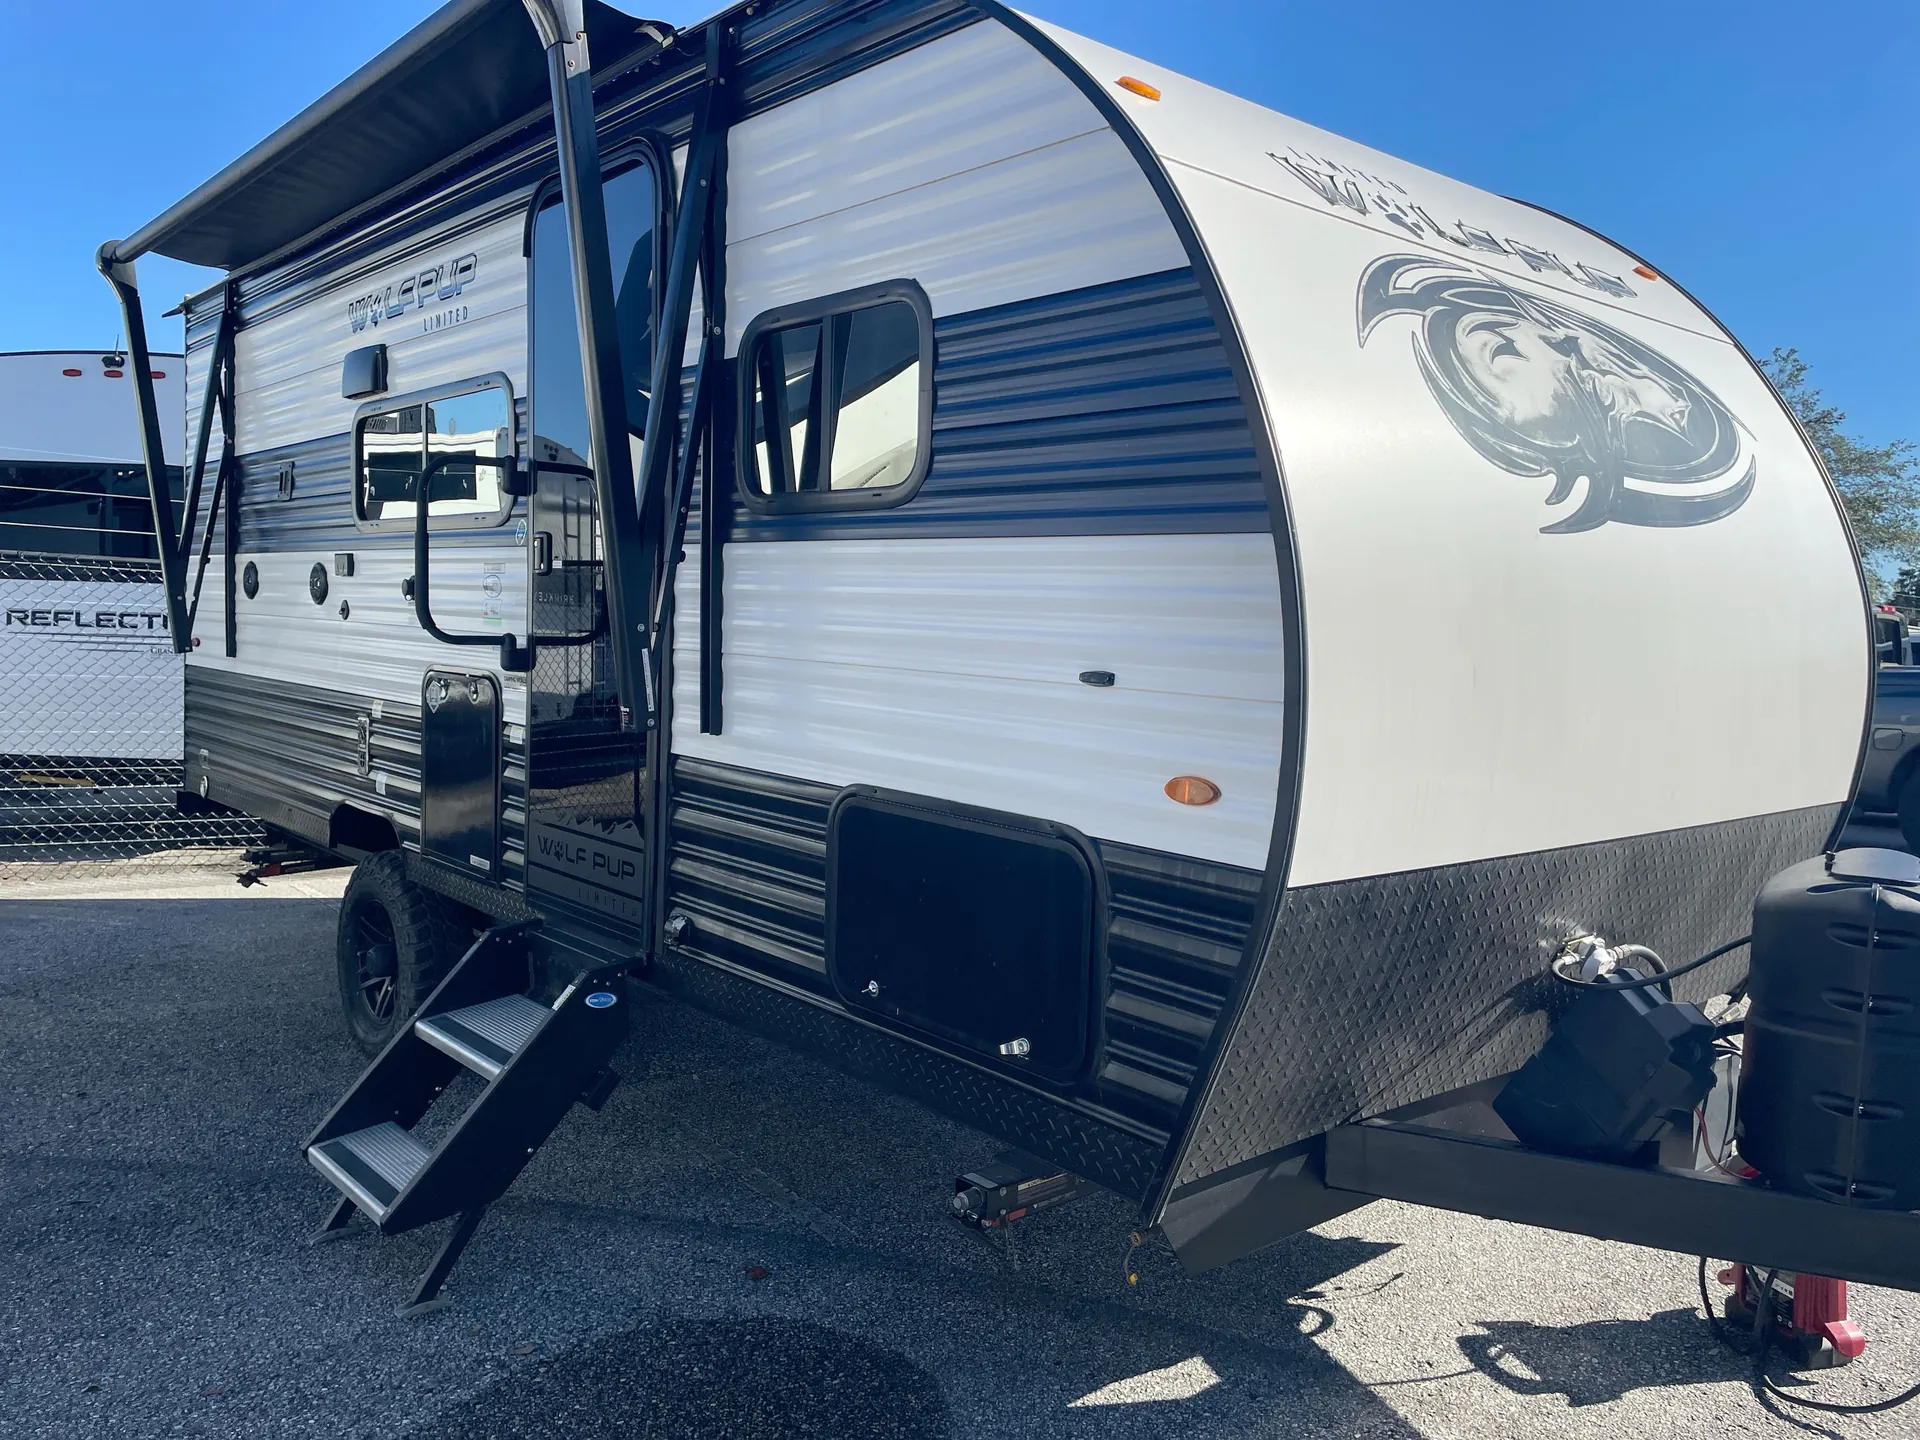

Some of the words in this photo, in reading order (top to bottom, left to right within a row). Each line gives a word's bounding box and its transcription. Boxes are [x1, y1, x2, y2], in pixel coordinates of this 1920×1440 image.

[423, 306, 468, 332] LIMITED
[5, 607, 169, 630] REFLECTI
[592, 851, 636, 880] PUP
